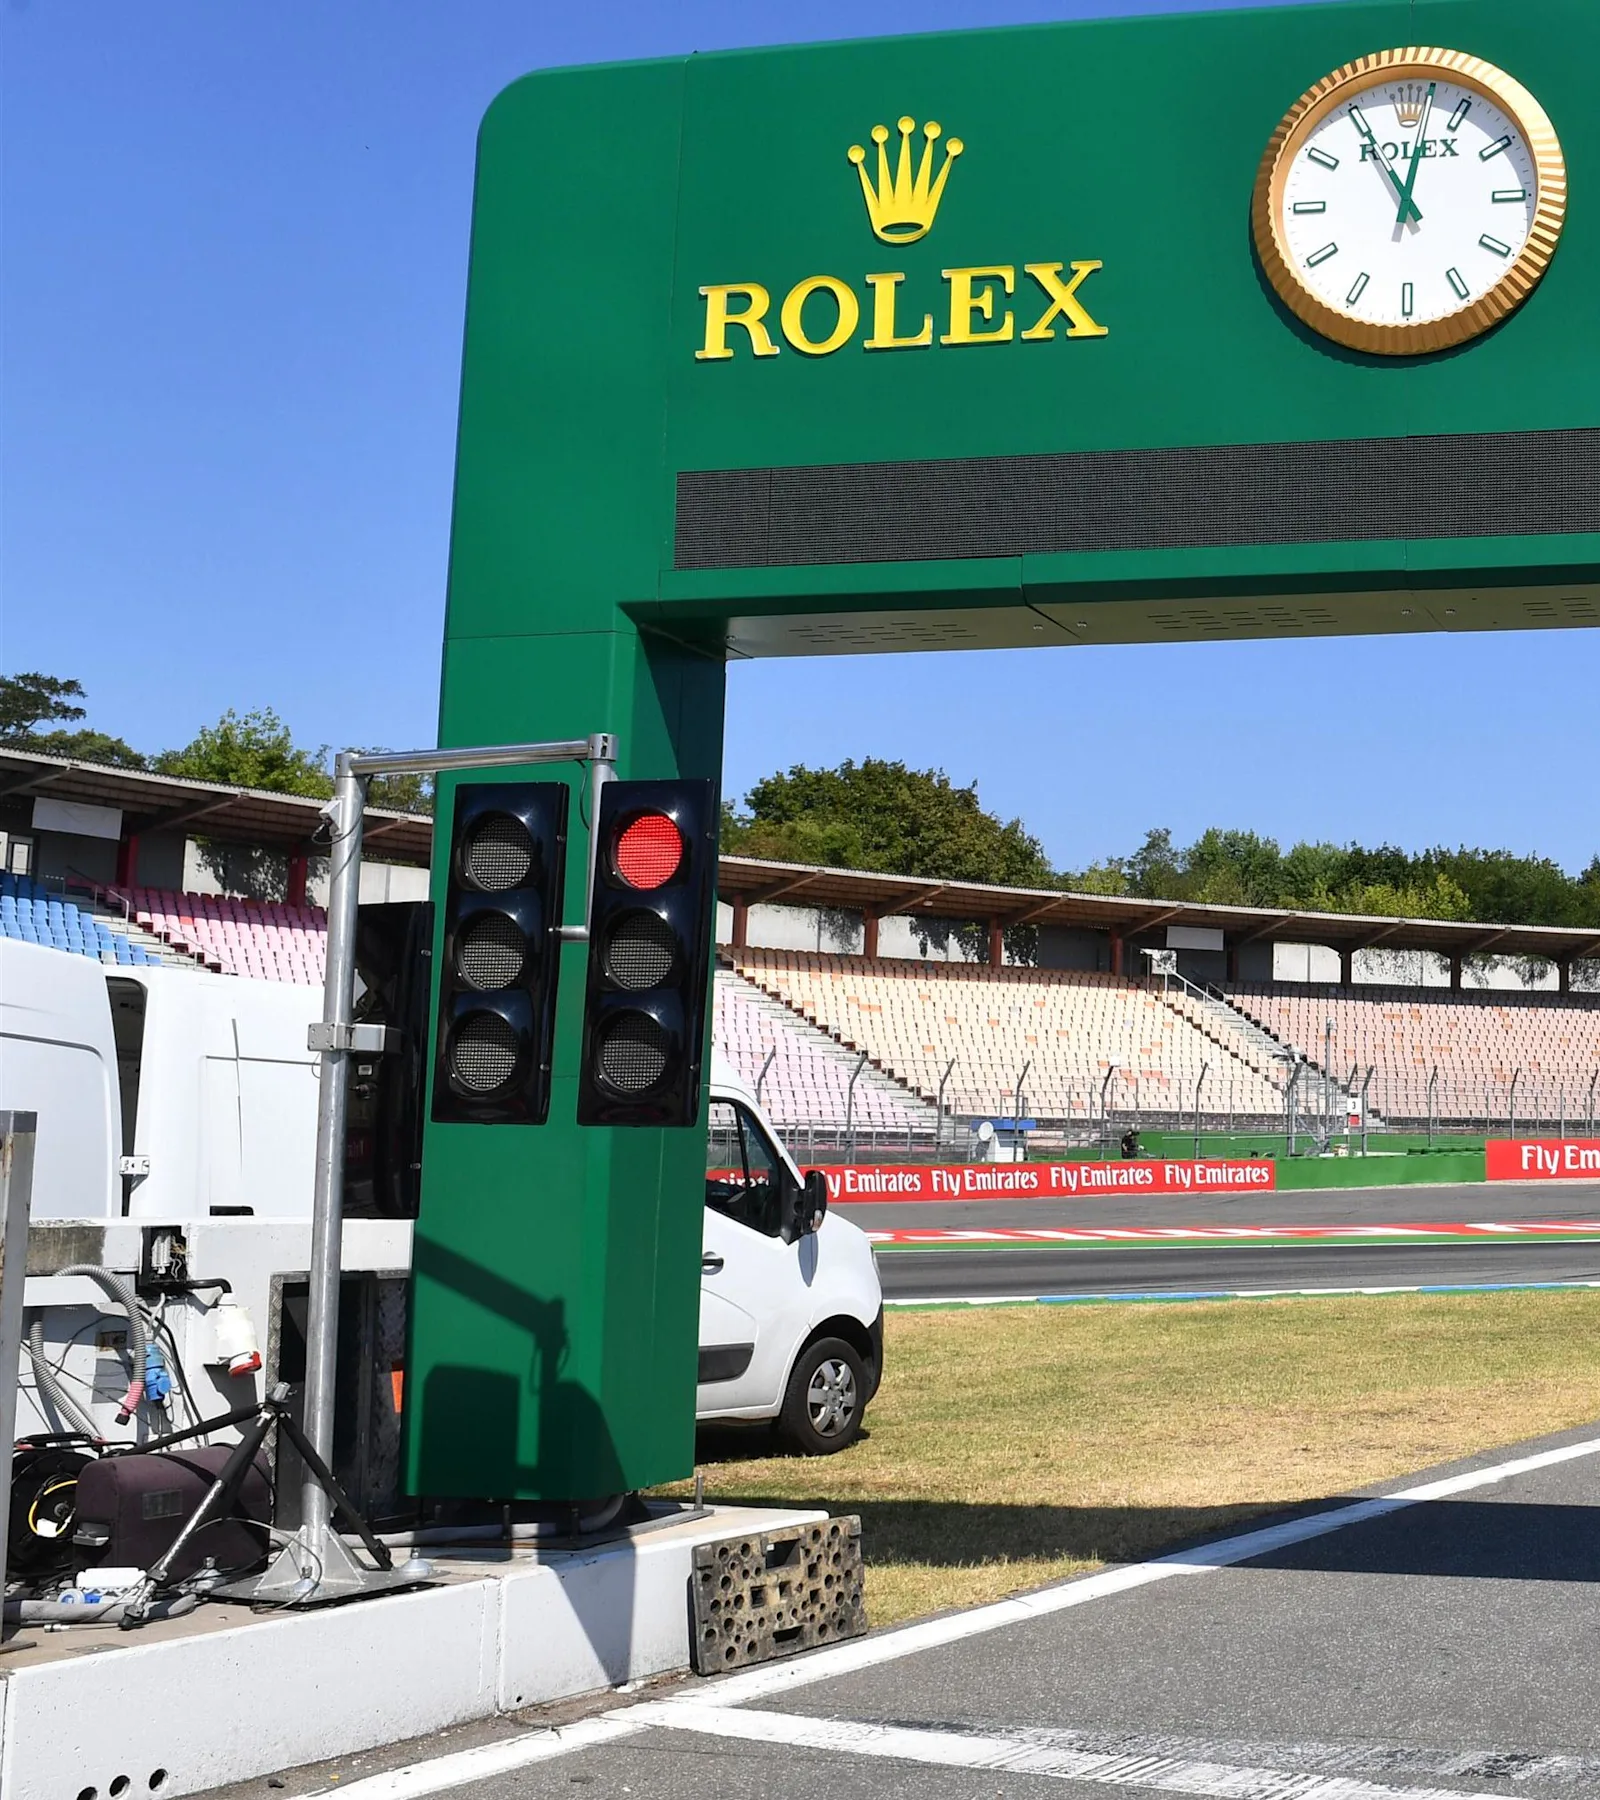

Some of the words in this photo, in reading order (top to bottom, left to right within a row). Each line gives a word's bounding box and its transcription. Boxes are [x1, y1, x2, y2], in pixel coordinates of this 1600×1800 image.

[1359, 138, 1459, 163] ROLEX
[694, 259, 1109, 361] ROLEX
[1520, 1144, 1560, 1175] Fly
[843, 1168, 922, 1194] Emirates
[931, 1169, 961, 1198] Fly
[963, 1168, 1039, 1192] Emirates
[1049, 1166, 1078, 1192] Fly
[1080, 1164, 1154, 1187] Emirates
[1164, 1164, 1192, 1189] Fly
[1193, 1163, 1270, 1185] Emirates
